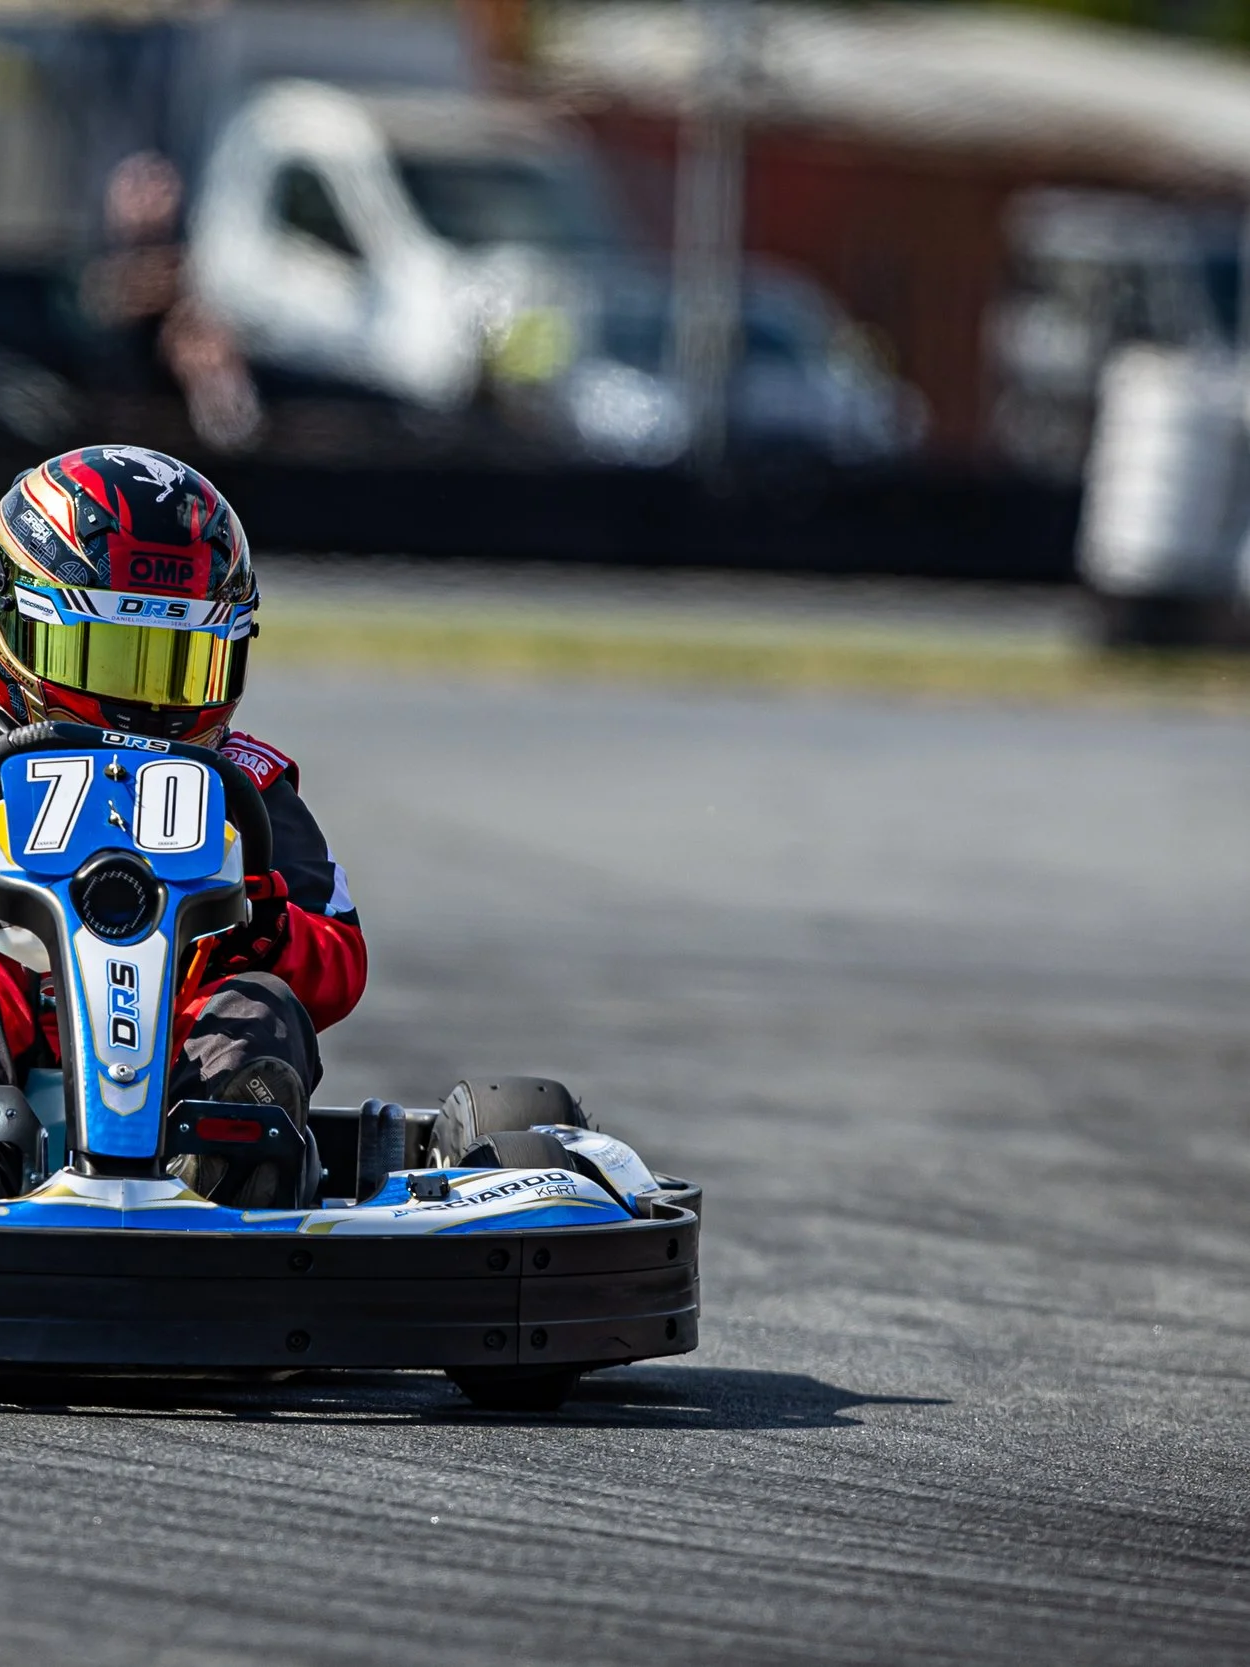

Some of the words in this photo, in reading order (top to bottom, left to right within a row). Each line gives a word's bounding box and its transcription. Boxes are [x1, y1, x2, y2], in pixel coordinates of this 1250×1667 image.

[130, 557, 194, 585] OMP
[118, 597, 189, 619] DRS
[103, 731, 170, 753] DRS
[23, 756, 209, 855] 70
[108, 960, 138, 1050] DRS
[250, 1078, 272, 1104] OMP
[395, 1172, 569, 1216] CCIARDO
[535, 1184, 578, 1198] KART
